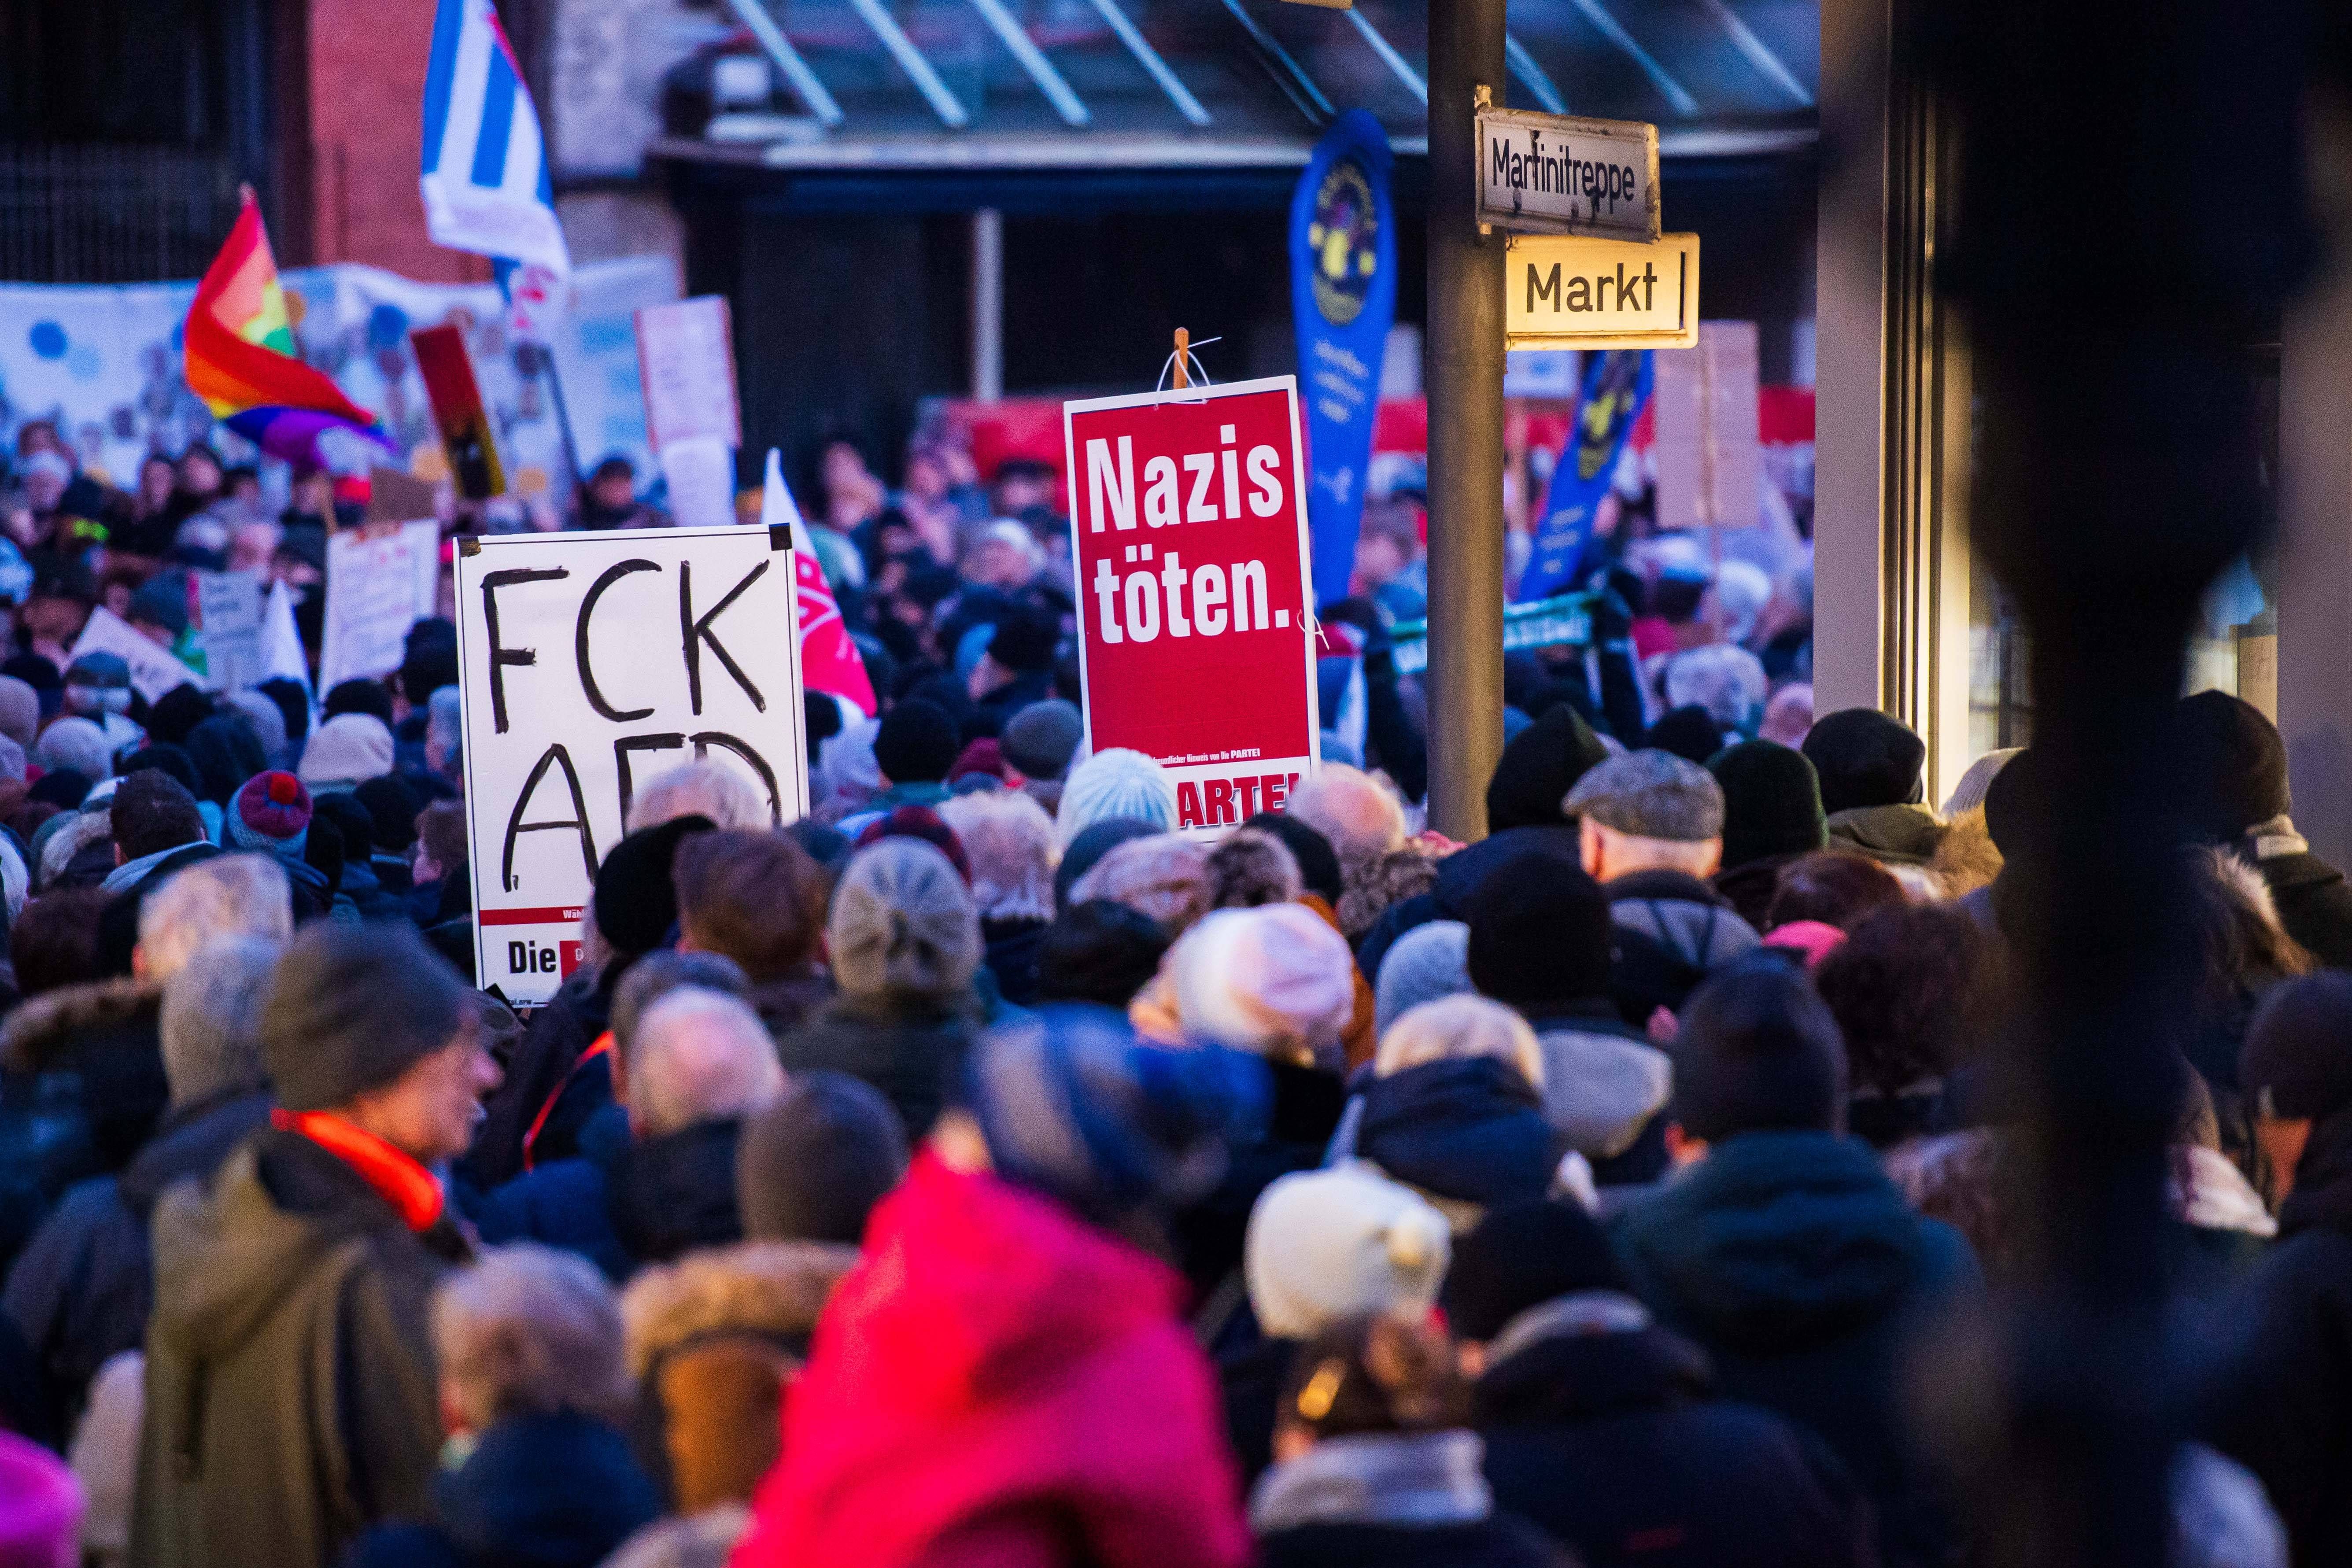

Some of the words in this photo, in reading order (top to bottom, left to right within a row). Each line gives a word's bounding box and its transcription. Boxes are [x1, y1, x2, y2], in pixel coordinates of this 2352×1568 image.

[1493, 137, 1635, 214] Martinitreppe
[1526, 262, 1658, 313] Markt
[1086, 424, 1284, 533] Nazis
[1094, 543, 1289, 644] töten.
[480, 558, 770, 734] FCK
[1186, 753, 1208, 763] Hinweis
[1220, 751, 1230, 760] Die
[1230, 748, 1260, 759] PARTEI
[508, 940, 557, 974] Die
